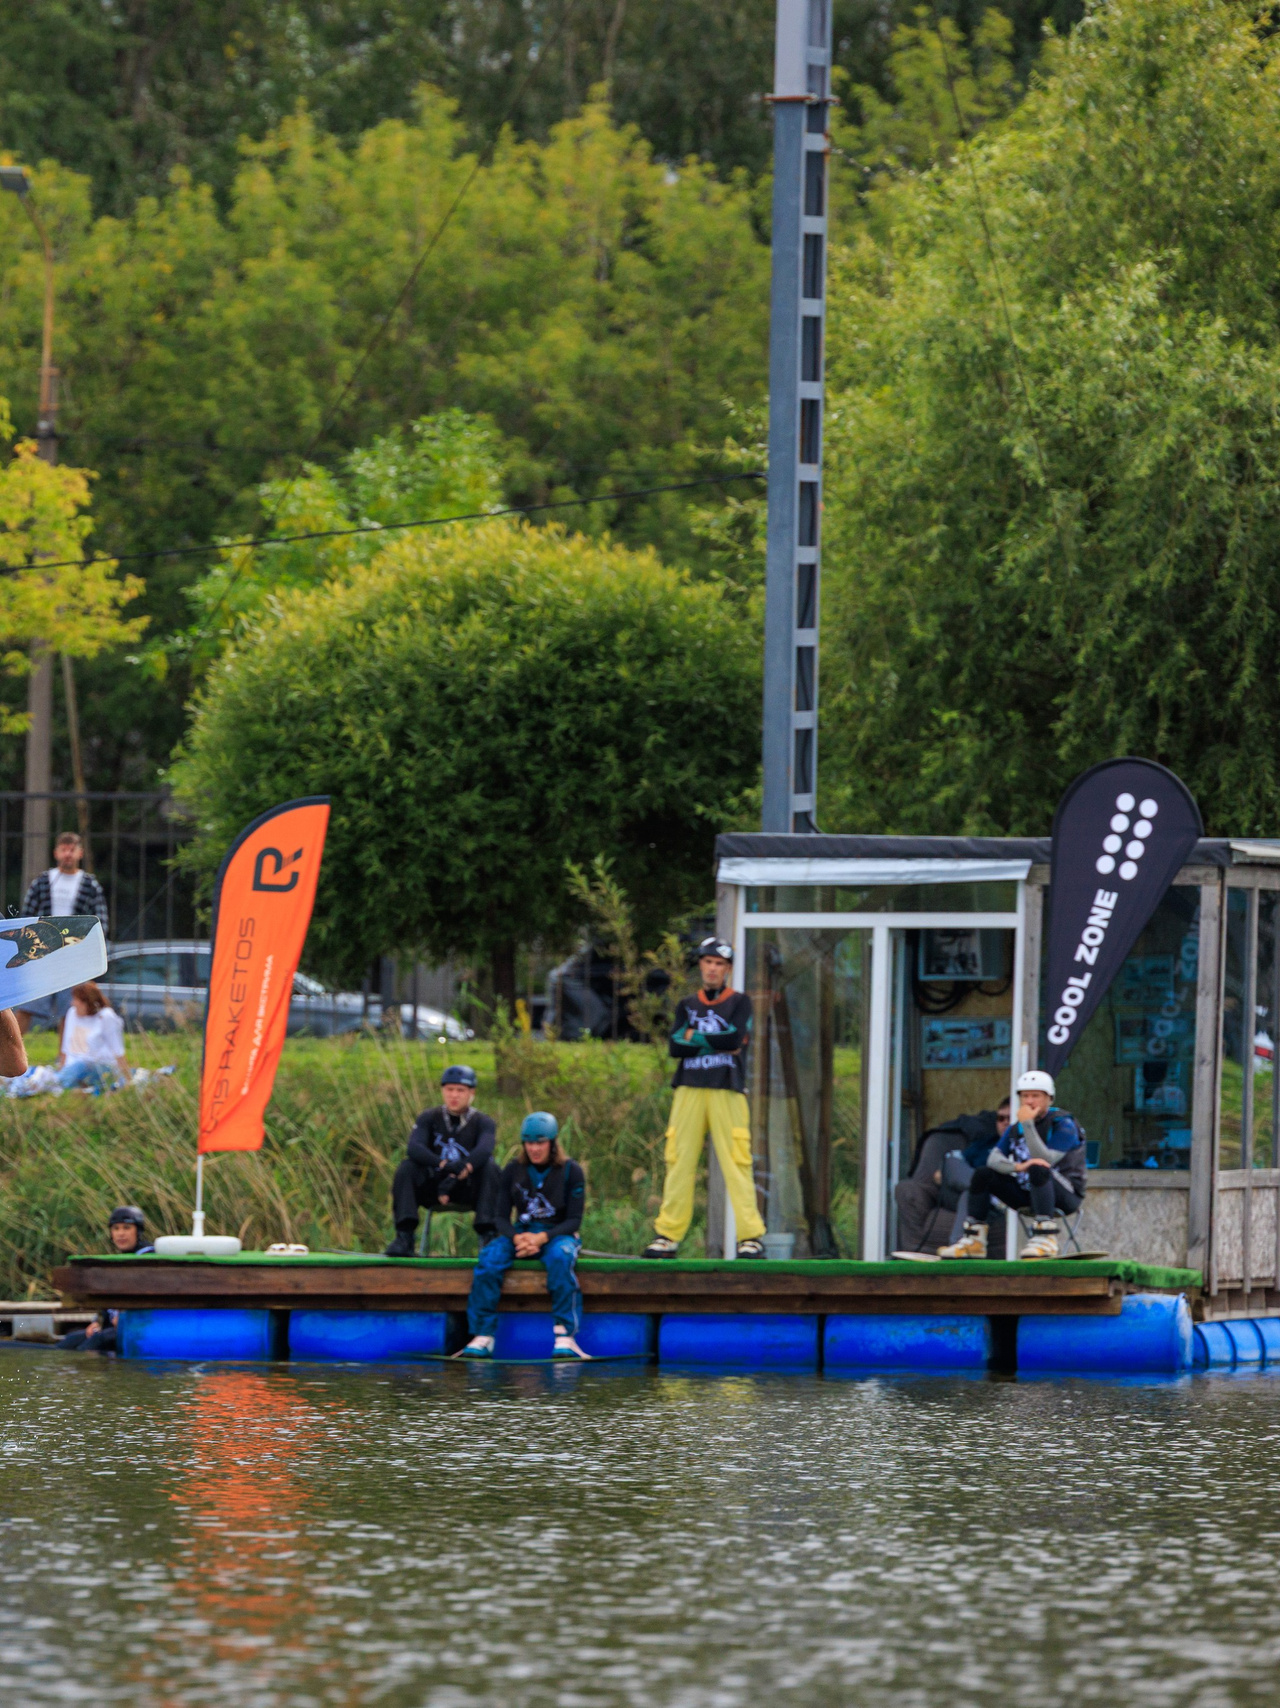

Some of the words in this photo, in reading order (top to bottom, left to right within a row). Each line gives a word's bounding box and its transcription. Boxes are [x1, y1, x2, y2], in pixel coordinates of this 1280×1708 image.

[219, 917, 256, 1070] RAKETOS
[1047, 972, 1092, 1045] COOL
[1074, 888, 1118, 966] ZONE
